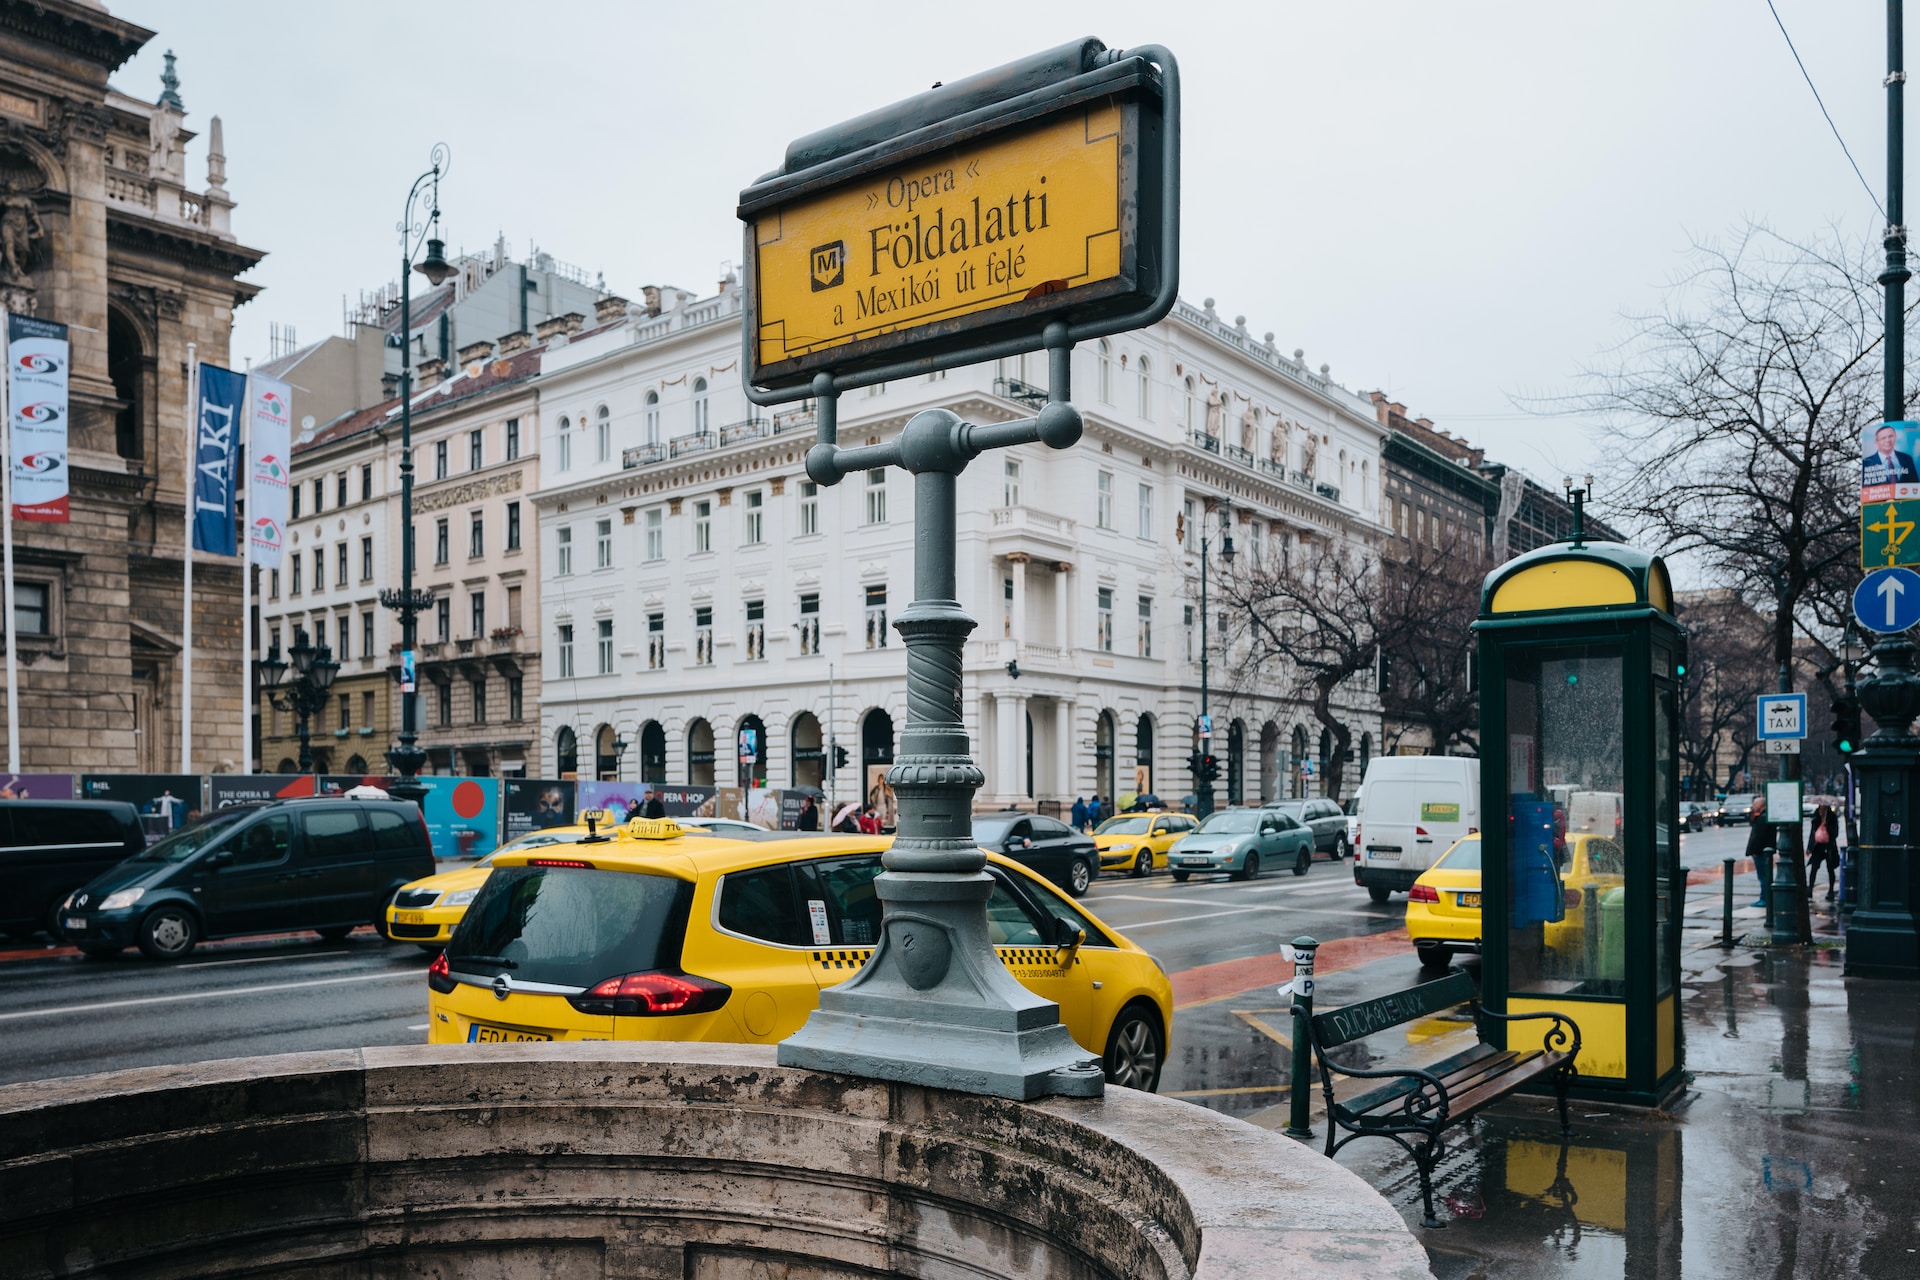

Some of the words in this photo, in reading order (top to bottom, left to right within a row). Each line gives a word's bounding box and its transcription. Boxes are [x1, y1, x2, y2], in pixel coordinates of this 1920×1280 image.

[886, 167, 956, 213] Opera
[869, 176, 1050, 277] Földalatti
[818, 251, 837, 273] M
[833, 303, 843, 326] a
[856, 268, 940, 321] Mexikói
[956, 260, 976, 294] út
[986, 245, 1027, 288] felé
[196, 396, 234, 518] LAKI
[1768, 717, 1797, 729] TAXI
[218, 790, 236, 798] THE
[236, 790, 260, 798] OPERA
